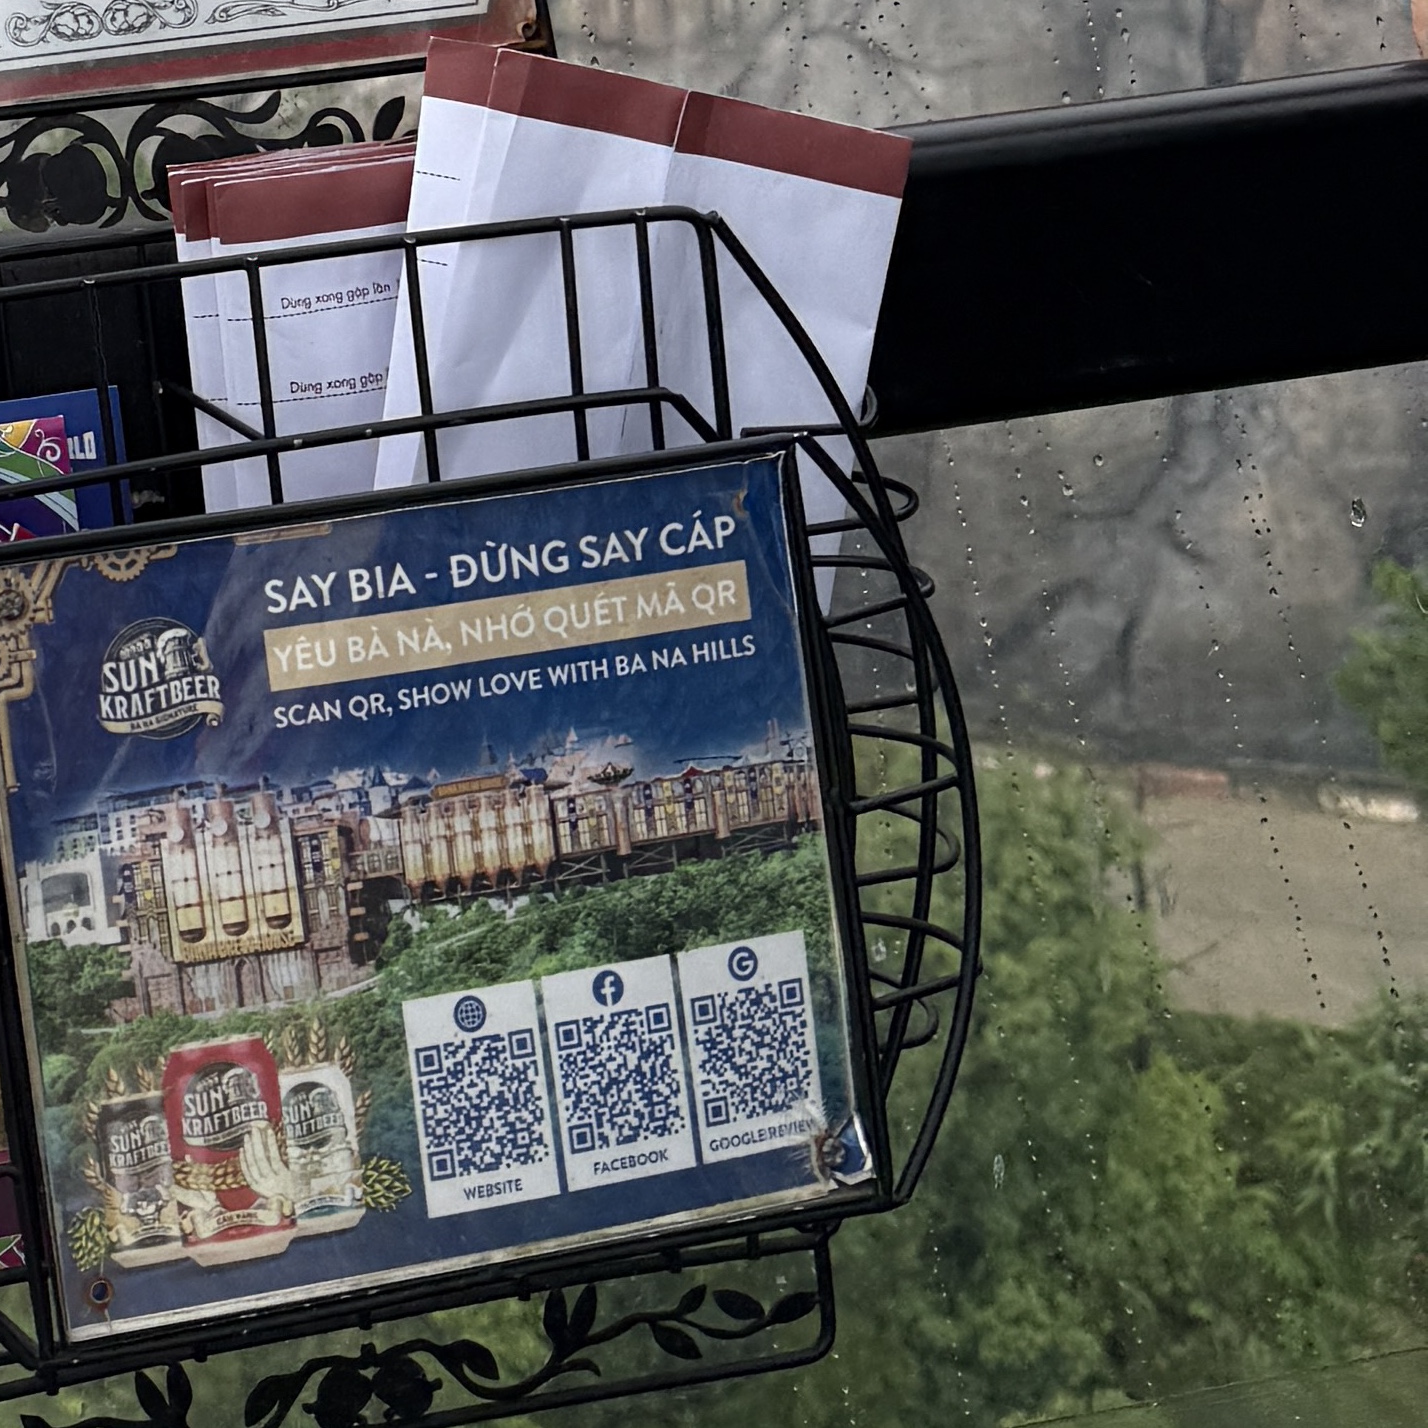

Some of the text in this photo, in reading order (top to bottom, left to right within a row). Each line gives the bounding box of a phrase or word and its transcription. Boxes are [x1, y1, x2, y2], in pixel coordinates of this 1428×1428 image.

[315, 291, 343, 304] xong
[326, 377, 356, 390] xong
[264, 570, 337, 613] SAY
[348, 562, 417, 603] BIA
[450, 540, 570, 589] ĐỪNG
[579, 527, 649, 569] SAY
[659, 510, 736, 556] CÁP
[273, 580, 736, 673] YÊU BÀ NÀ, NHỚ QUÉT MÃ QR
[102, 651, 161, 693] SUN
[273, 634, 756, 729] SCAN QR, SHOW LOVE WITH BA NA HILLS
[99, 675, 221, 720] KRAFTBEER
[184, 1084, 225, 1118] SUN
[181, 1100, 270, 1137] KRAFTBEER
[110, 1129, 142, 1153] SUN
[709, 1127, 768, 1152] GOOGLE
[593, 1148, 669, 1176] FACEBOOK
[463, 1177, 523, 1201] WEBSITE
